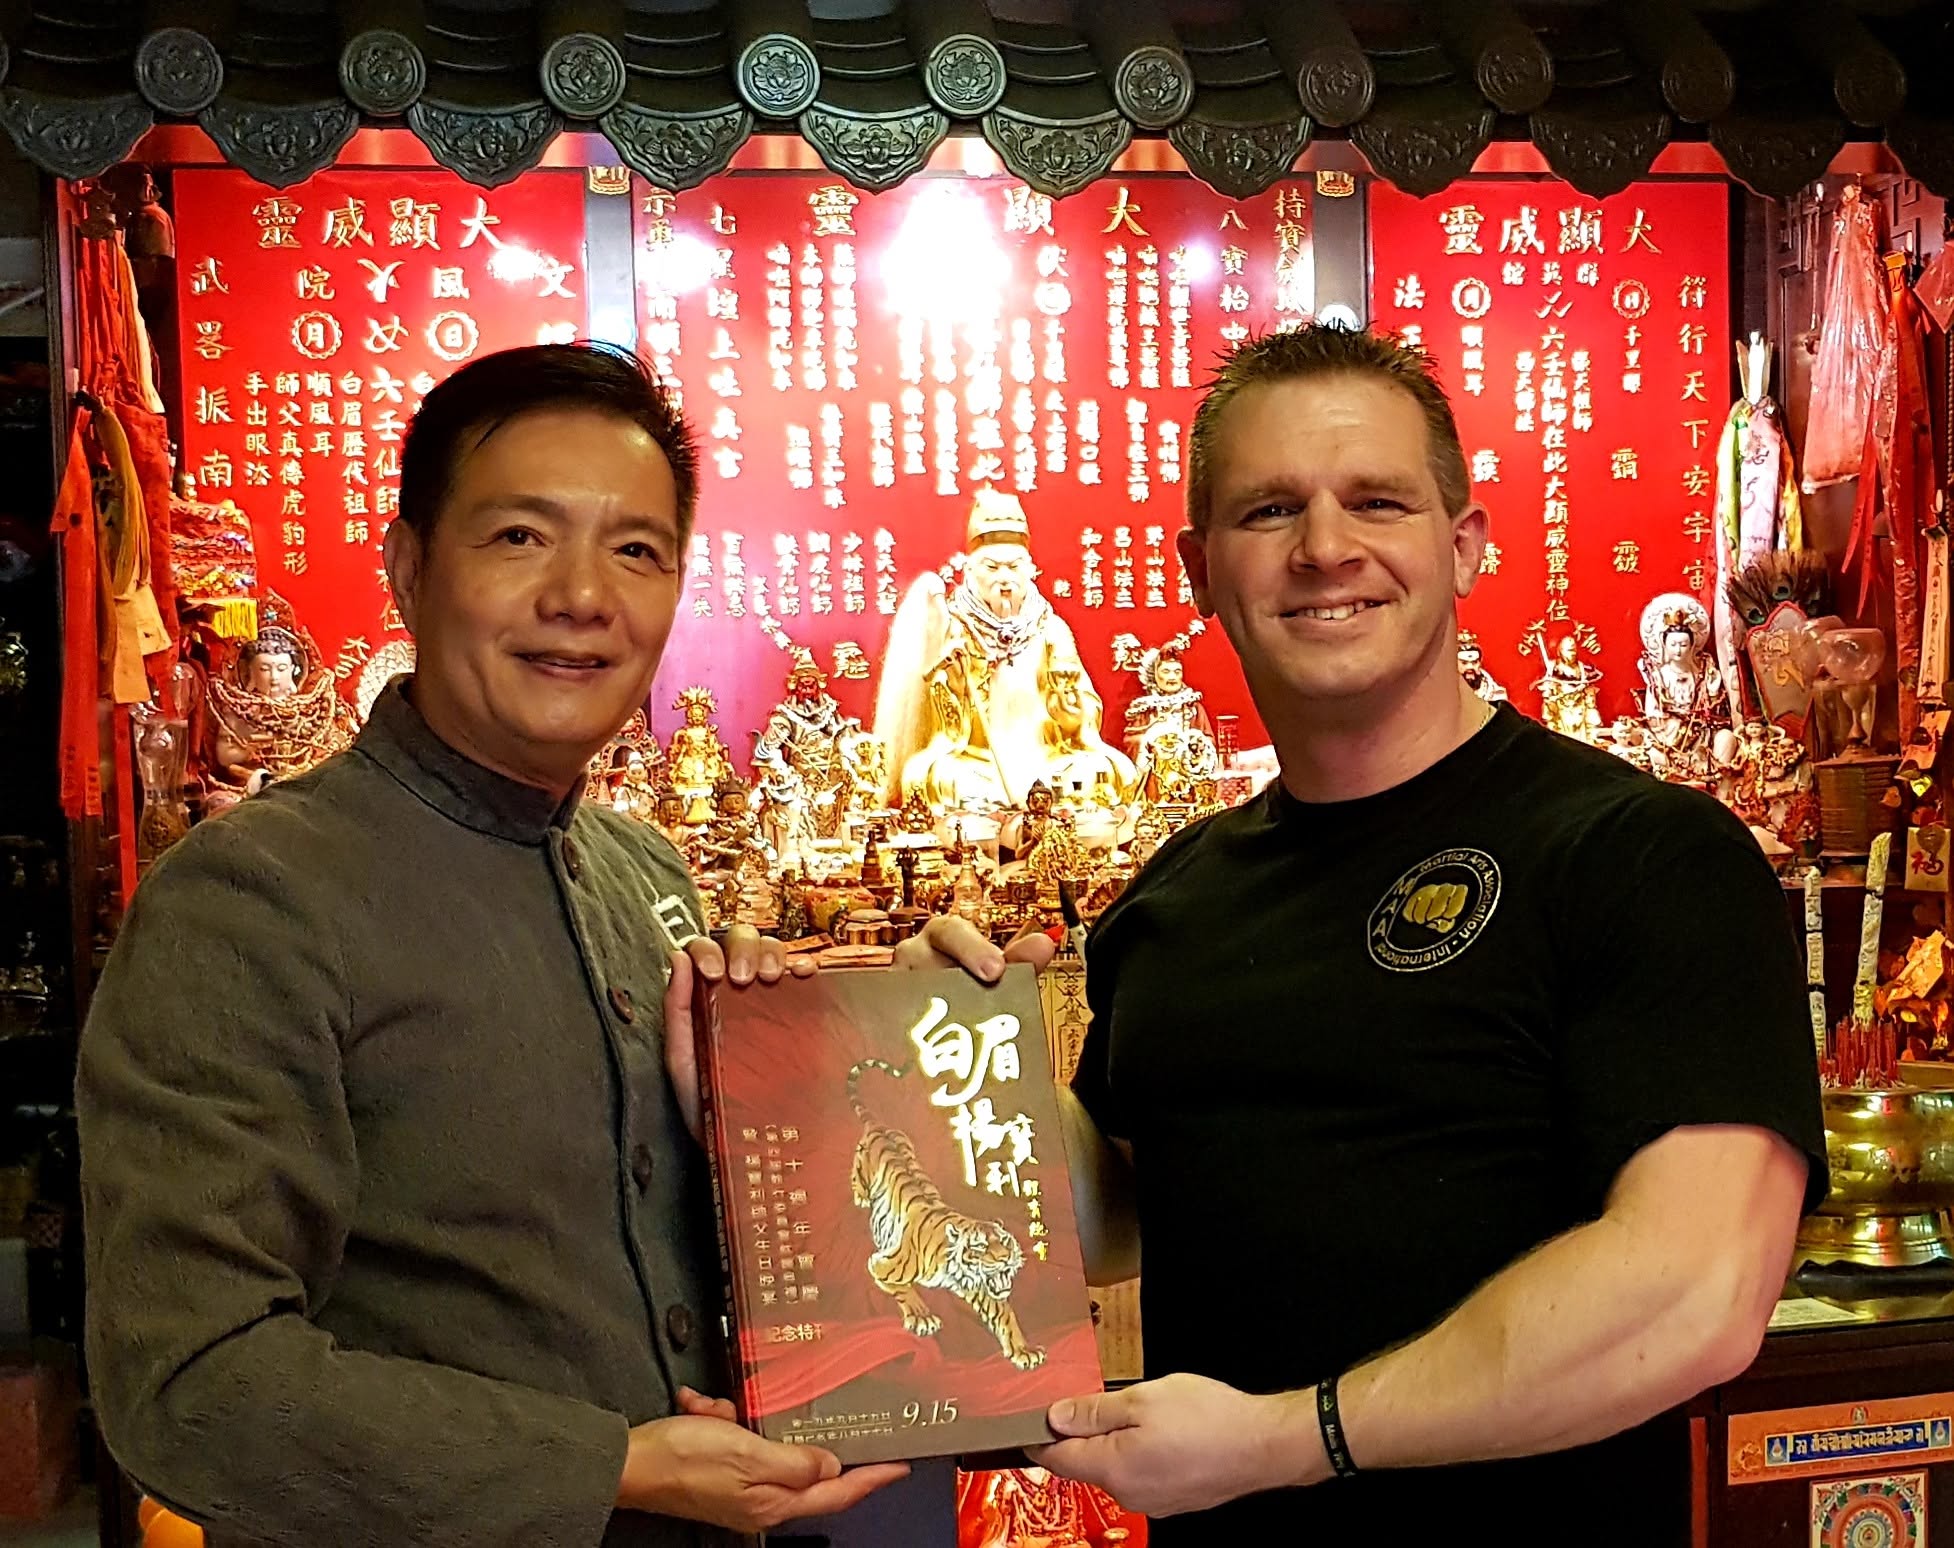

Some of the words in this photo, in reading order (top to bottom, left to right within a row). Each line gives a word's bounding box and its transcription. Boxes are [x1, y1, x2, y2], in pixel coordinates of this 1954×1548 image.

[252, 195, 505, 250] 大顯威靈
[807, 184, 1151, 238] 大顯靈
[1438, 204, 1663, 256] 大顯威靈
[1467, 853, 1489, 872] Arts
[901, 1397, 958, 1429] 9.15
